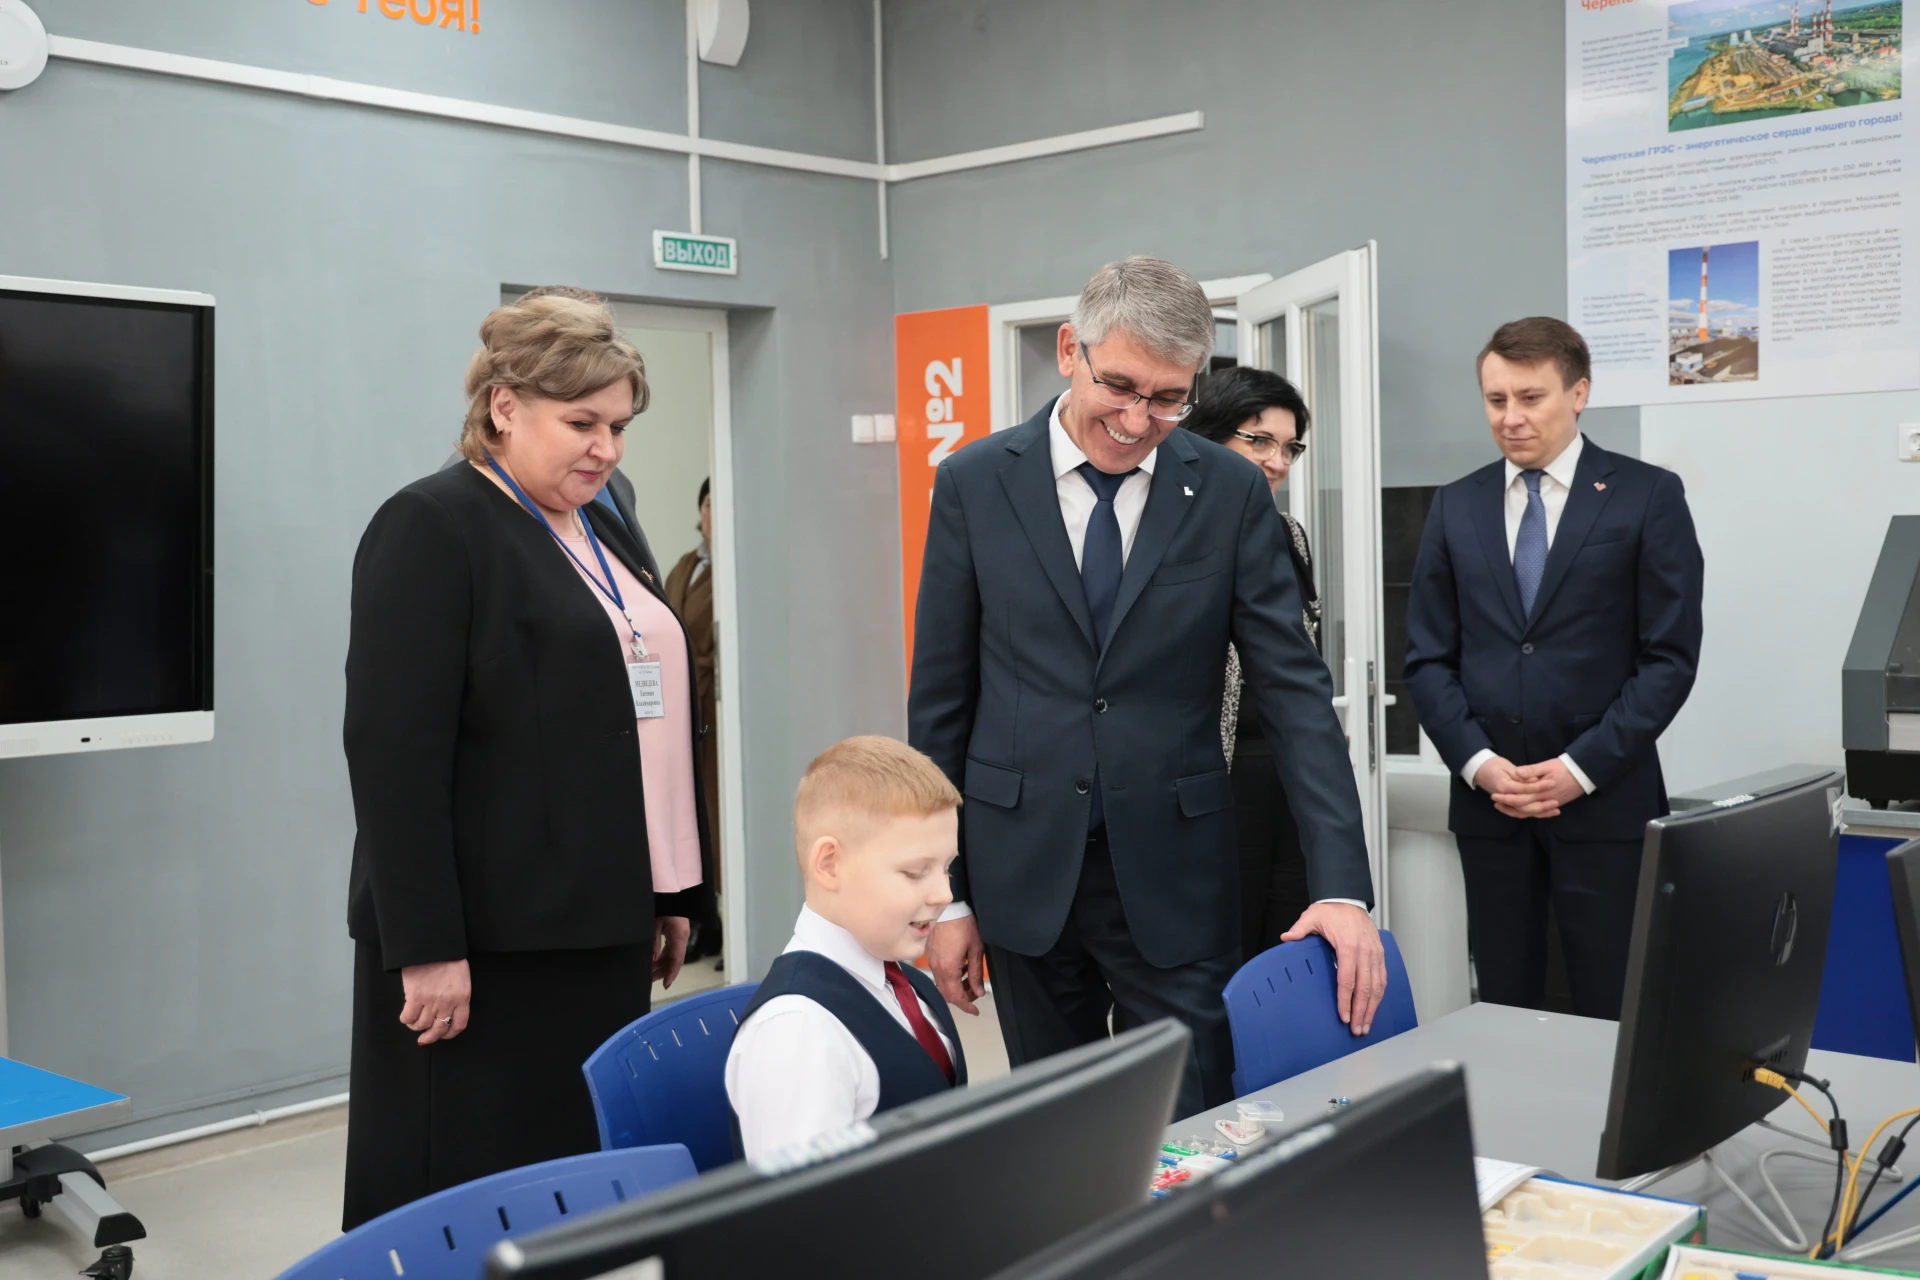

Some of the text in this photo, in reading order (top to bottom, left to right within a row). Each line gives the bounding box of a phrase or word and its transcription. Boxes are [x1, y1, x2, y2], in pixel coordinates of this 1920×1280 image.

[1581, 149, 1645, 165] Черепетская
[1647, 145, 1674, 156] ГРЭС
[1685, 133, 1769, 151] энергетическое
[1772, 126, 1811, 139] сердце
[1814, 120, 1855, 132] нашего
[1858, 111, 1902, 127] города!
[665, 240, 729, 267] ВЫХОД
[924, 356, 964, 468] №2
